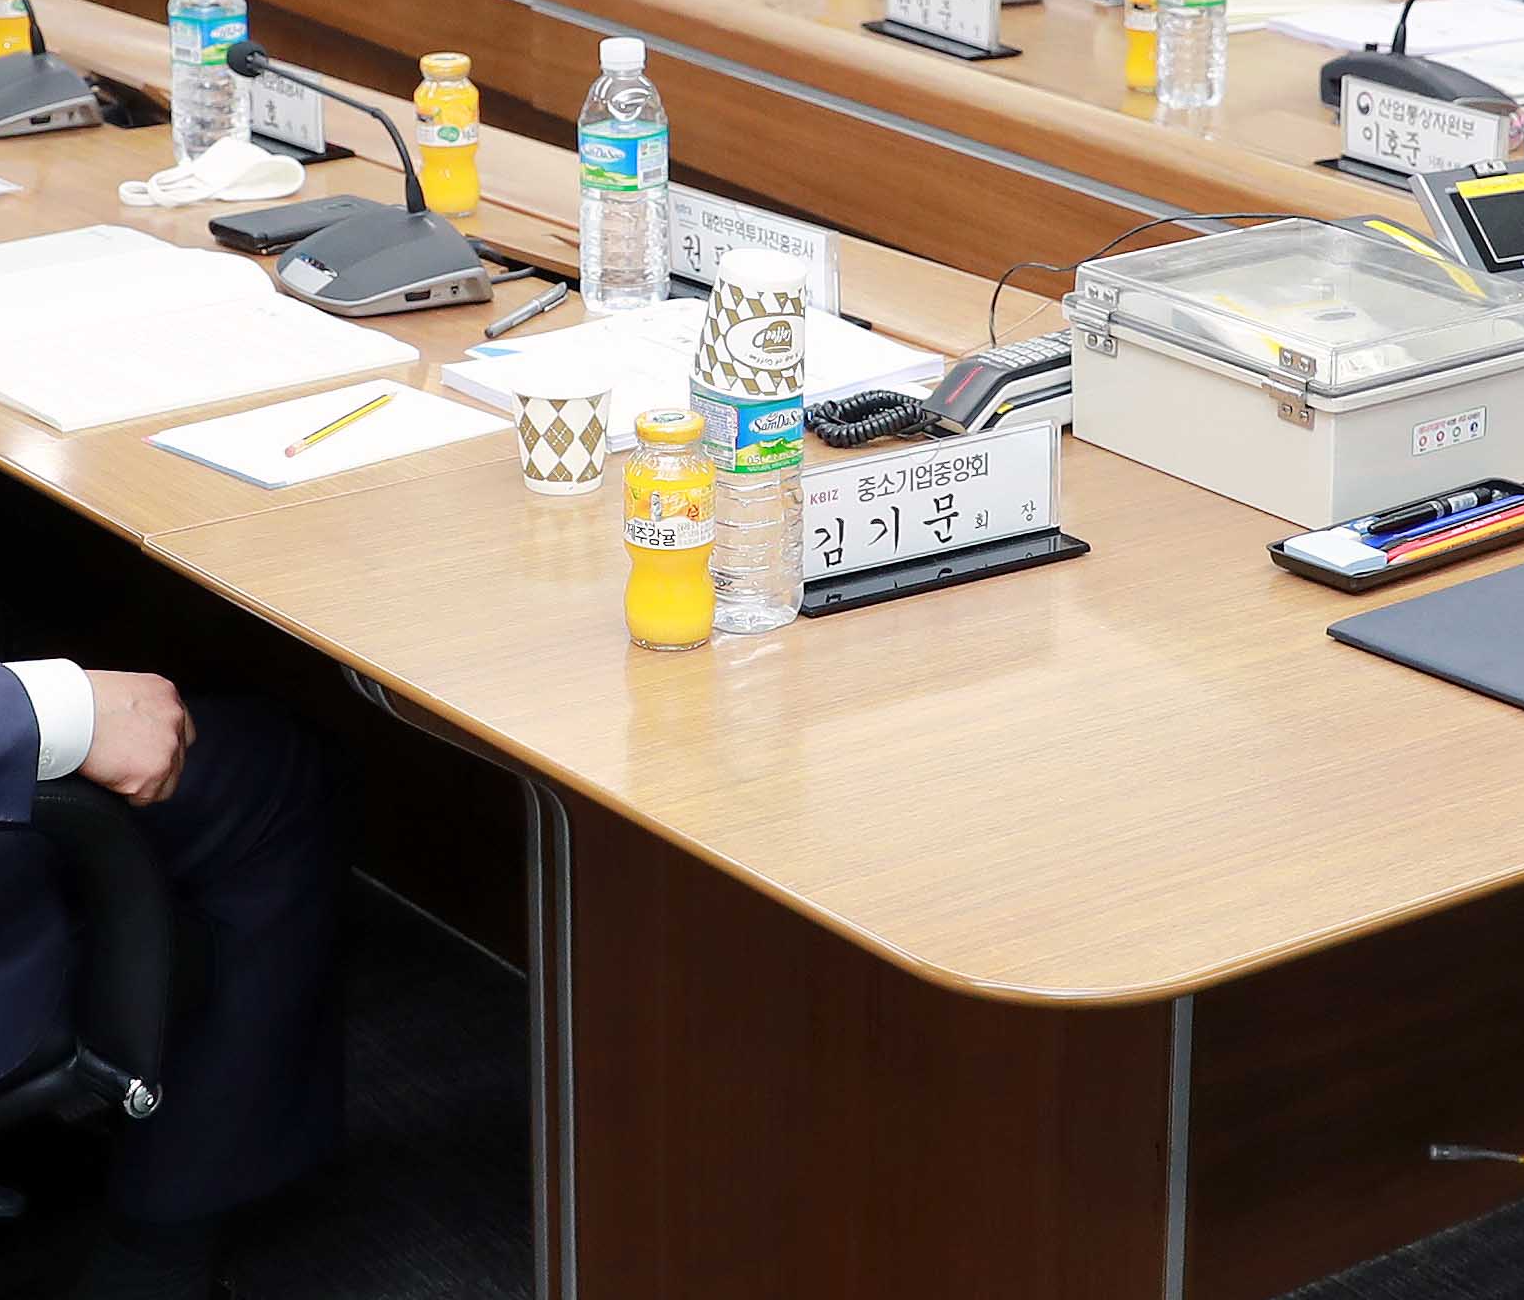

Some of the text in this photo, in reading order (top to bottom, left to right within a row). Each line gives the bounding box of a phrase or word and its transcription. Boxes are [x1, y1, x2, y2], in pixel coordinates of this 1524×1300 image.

[1378, 97, 1476, 141] 산업통상자원부
[1361, 120, 1422, 168] 이호준
[701, 210, 815, 260] 대한무역투자진흥공사
[809, 487, 840, 506] KBIZ
[856, 451, 989, 503] 중소기업중앙회
[626, 522, 677, 548] 제주감귤
